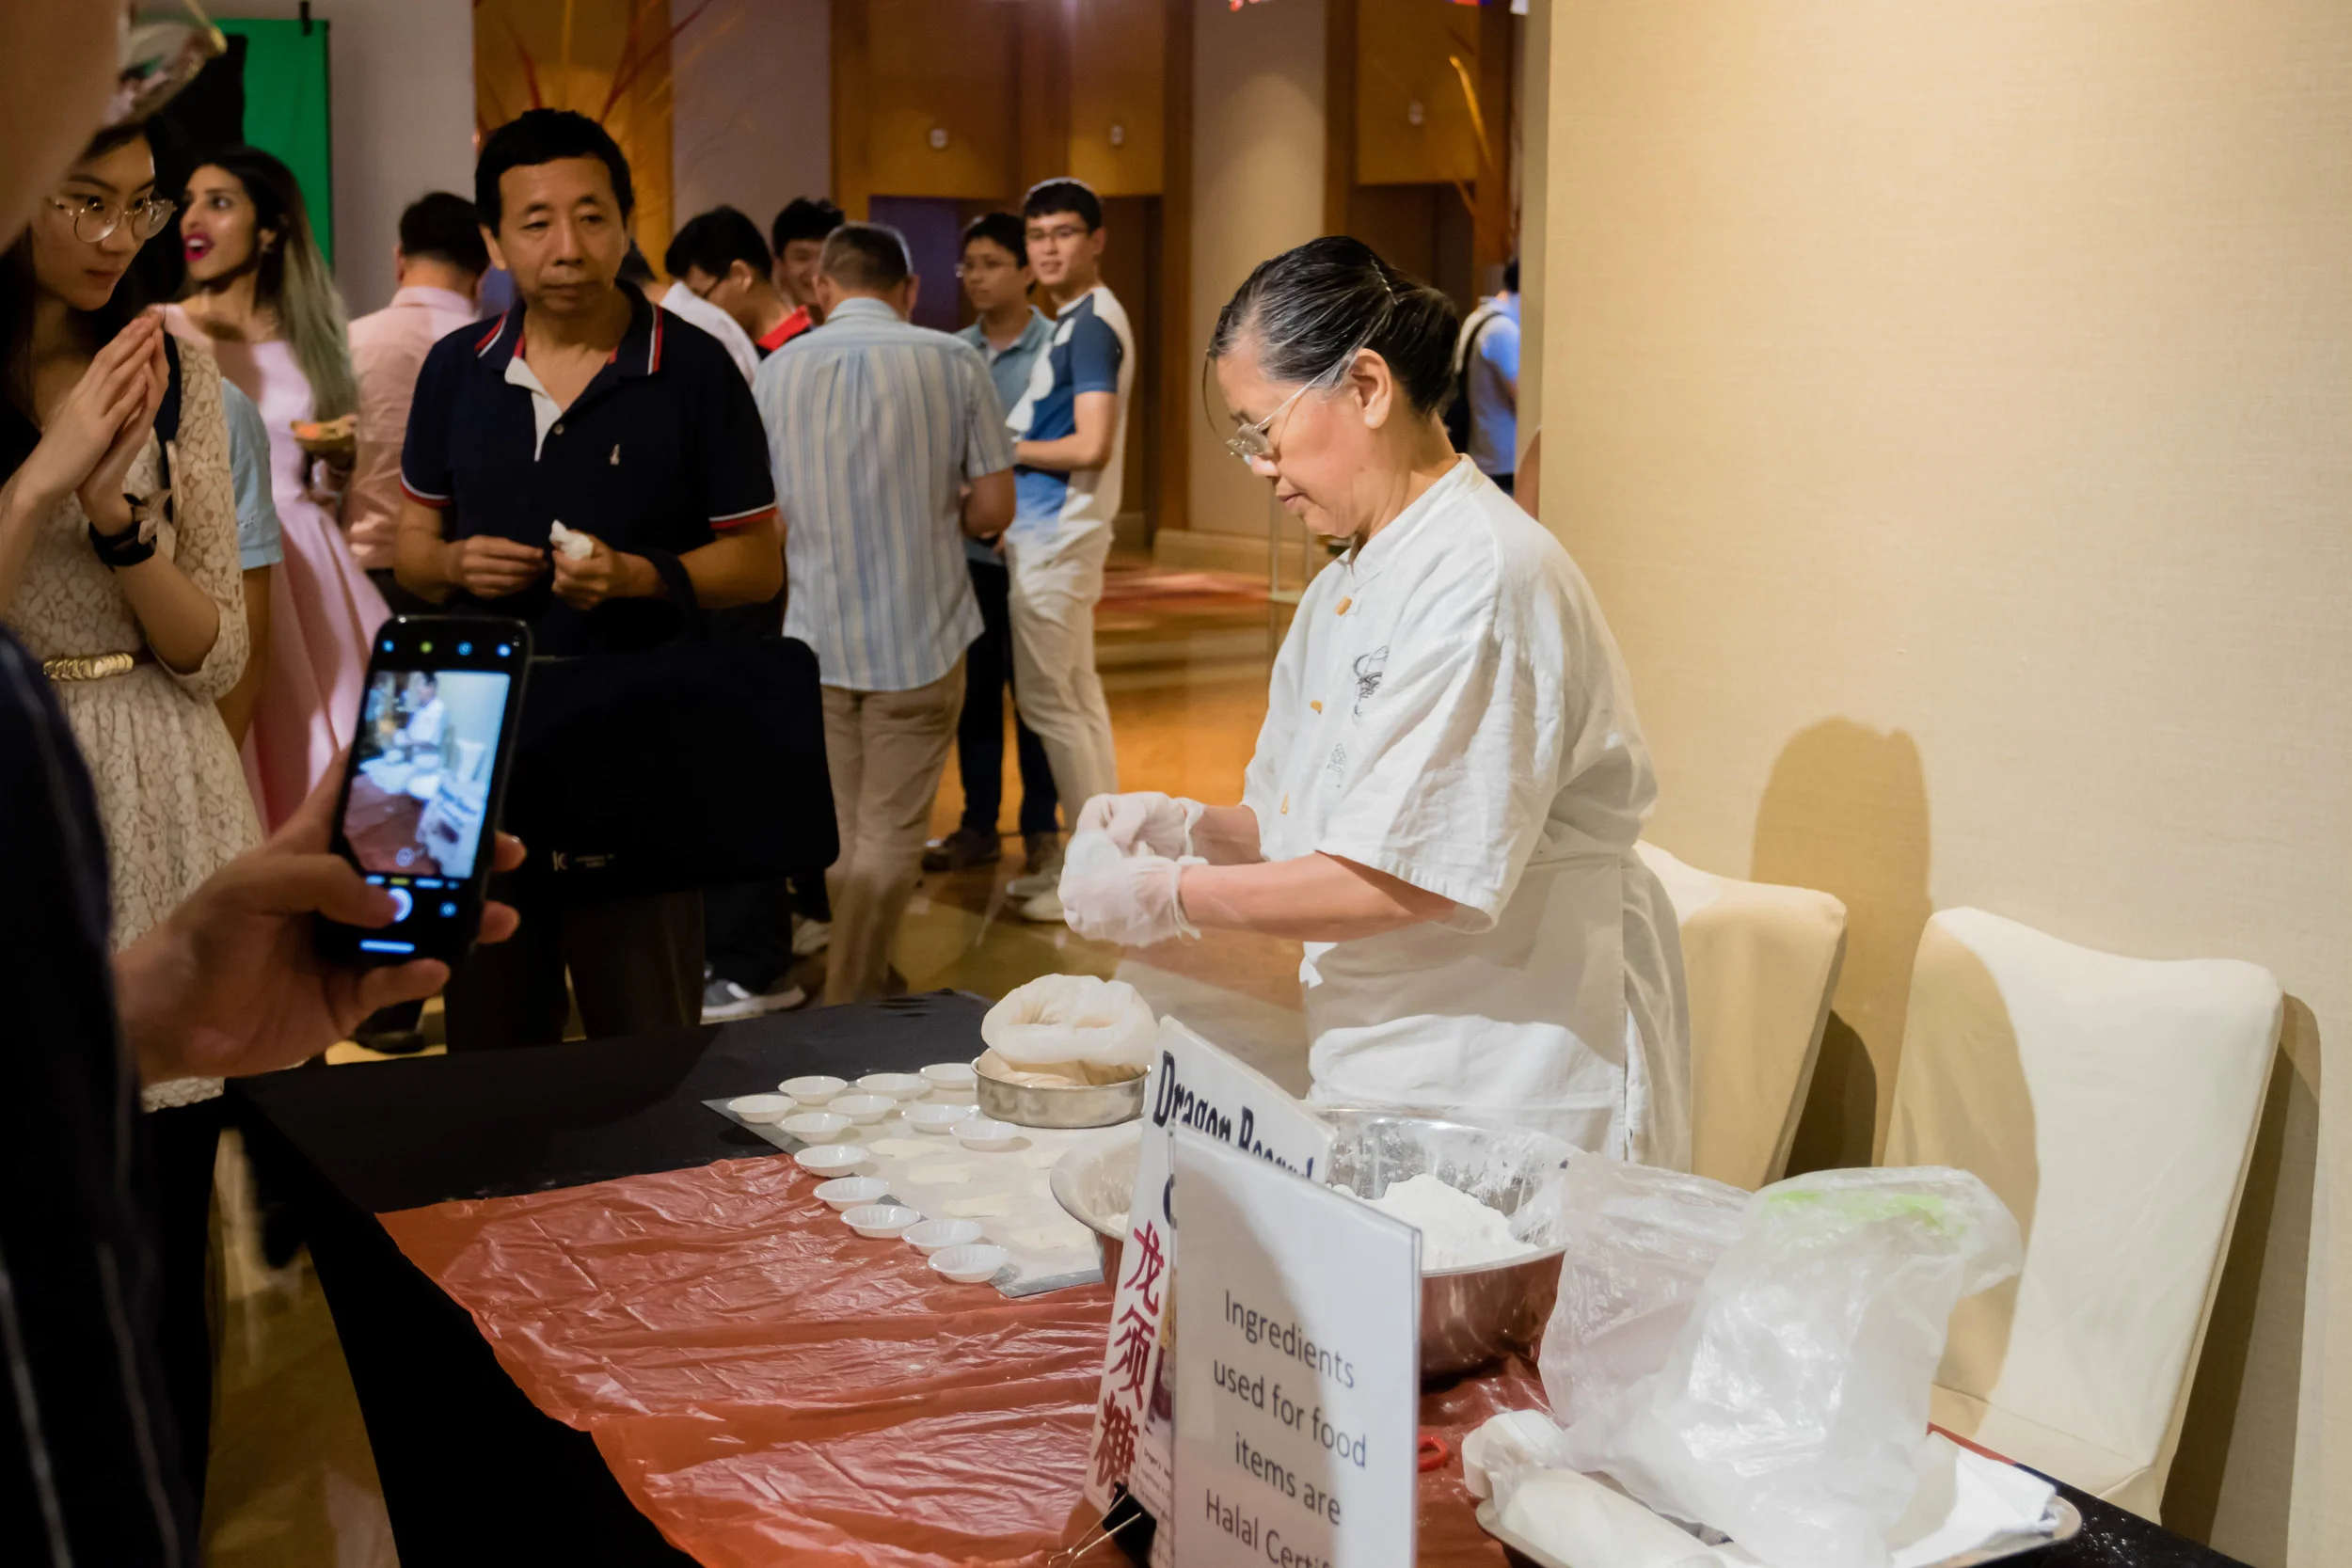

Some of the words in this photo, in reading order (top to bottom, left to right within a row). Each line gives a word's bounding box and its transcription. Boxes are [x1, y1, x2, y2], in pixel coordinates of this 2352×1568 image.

[1225, 1289, 1355, 1389] Ingredients
[1214, 1359, 1265, 1410] used
[1272, 1384, 1305, 1432] for
[1311, 1406, 1367, 1469] food
[1235, 1431, 1296, 1498] items
[1303, 1482, 1342, 1526] are
[1205, 1488, 1259, 1551] Halal
[1265, 1528, 1333, 1568] Cert
